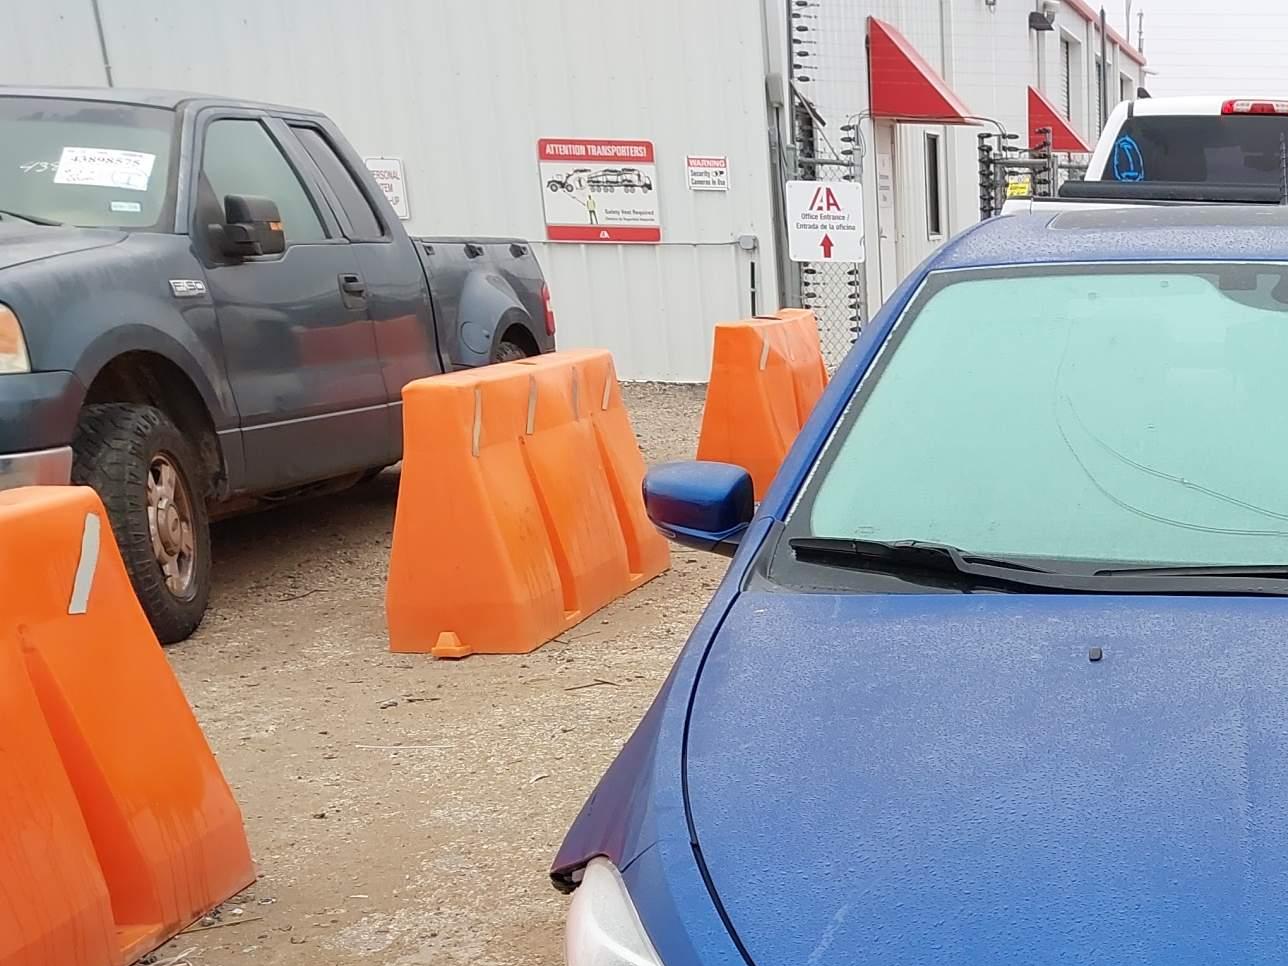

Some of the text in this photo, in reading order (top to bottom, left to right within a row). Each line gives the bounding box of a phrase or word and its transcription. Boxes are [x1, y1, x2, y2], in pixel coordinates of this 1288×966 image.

[545, 143, 647, 157] ATTENTION TRANSPORTERS!
[690, 159, 725, 168] WARNING
[370, 170, 401, 180] ERSONAL
[690, 169, 711, 178] Security
[801, 213, 819, 221] Office
[820, 213, 846, 221] Entrance
[796, 222, 819, 230] Entrada
[835, 223, 856, 231] oficina
